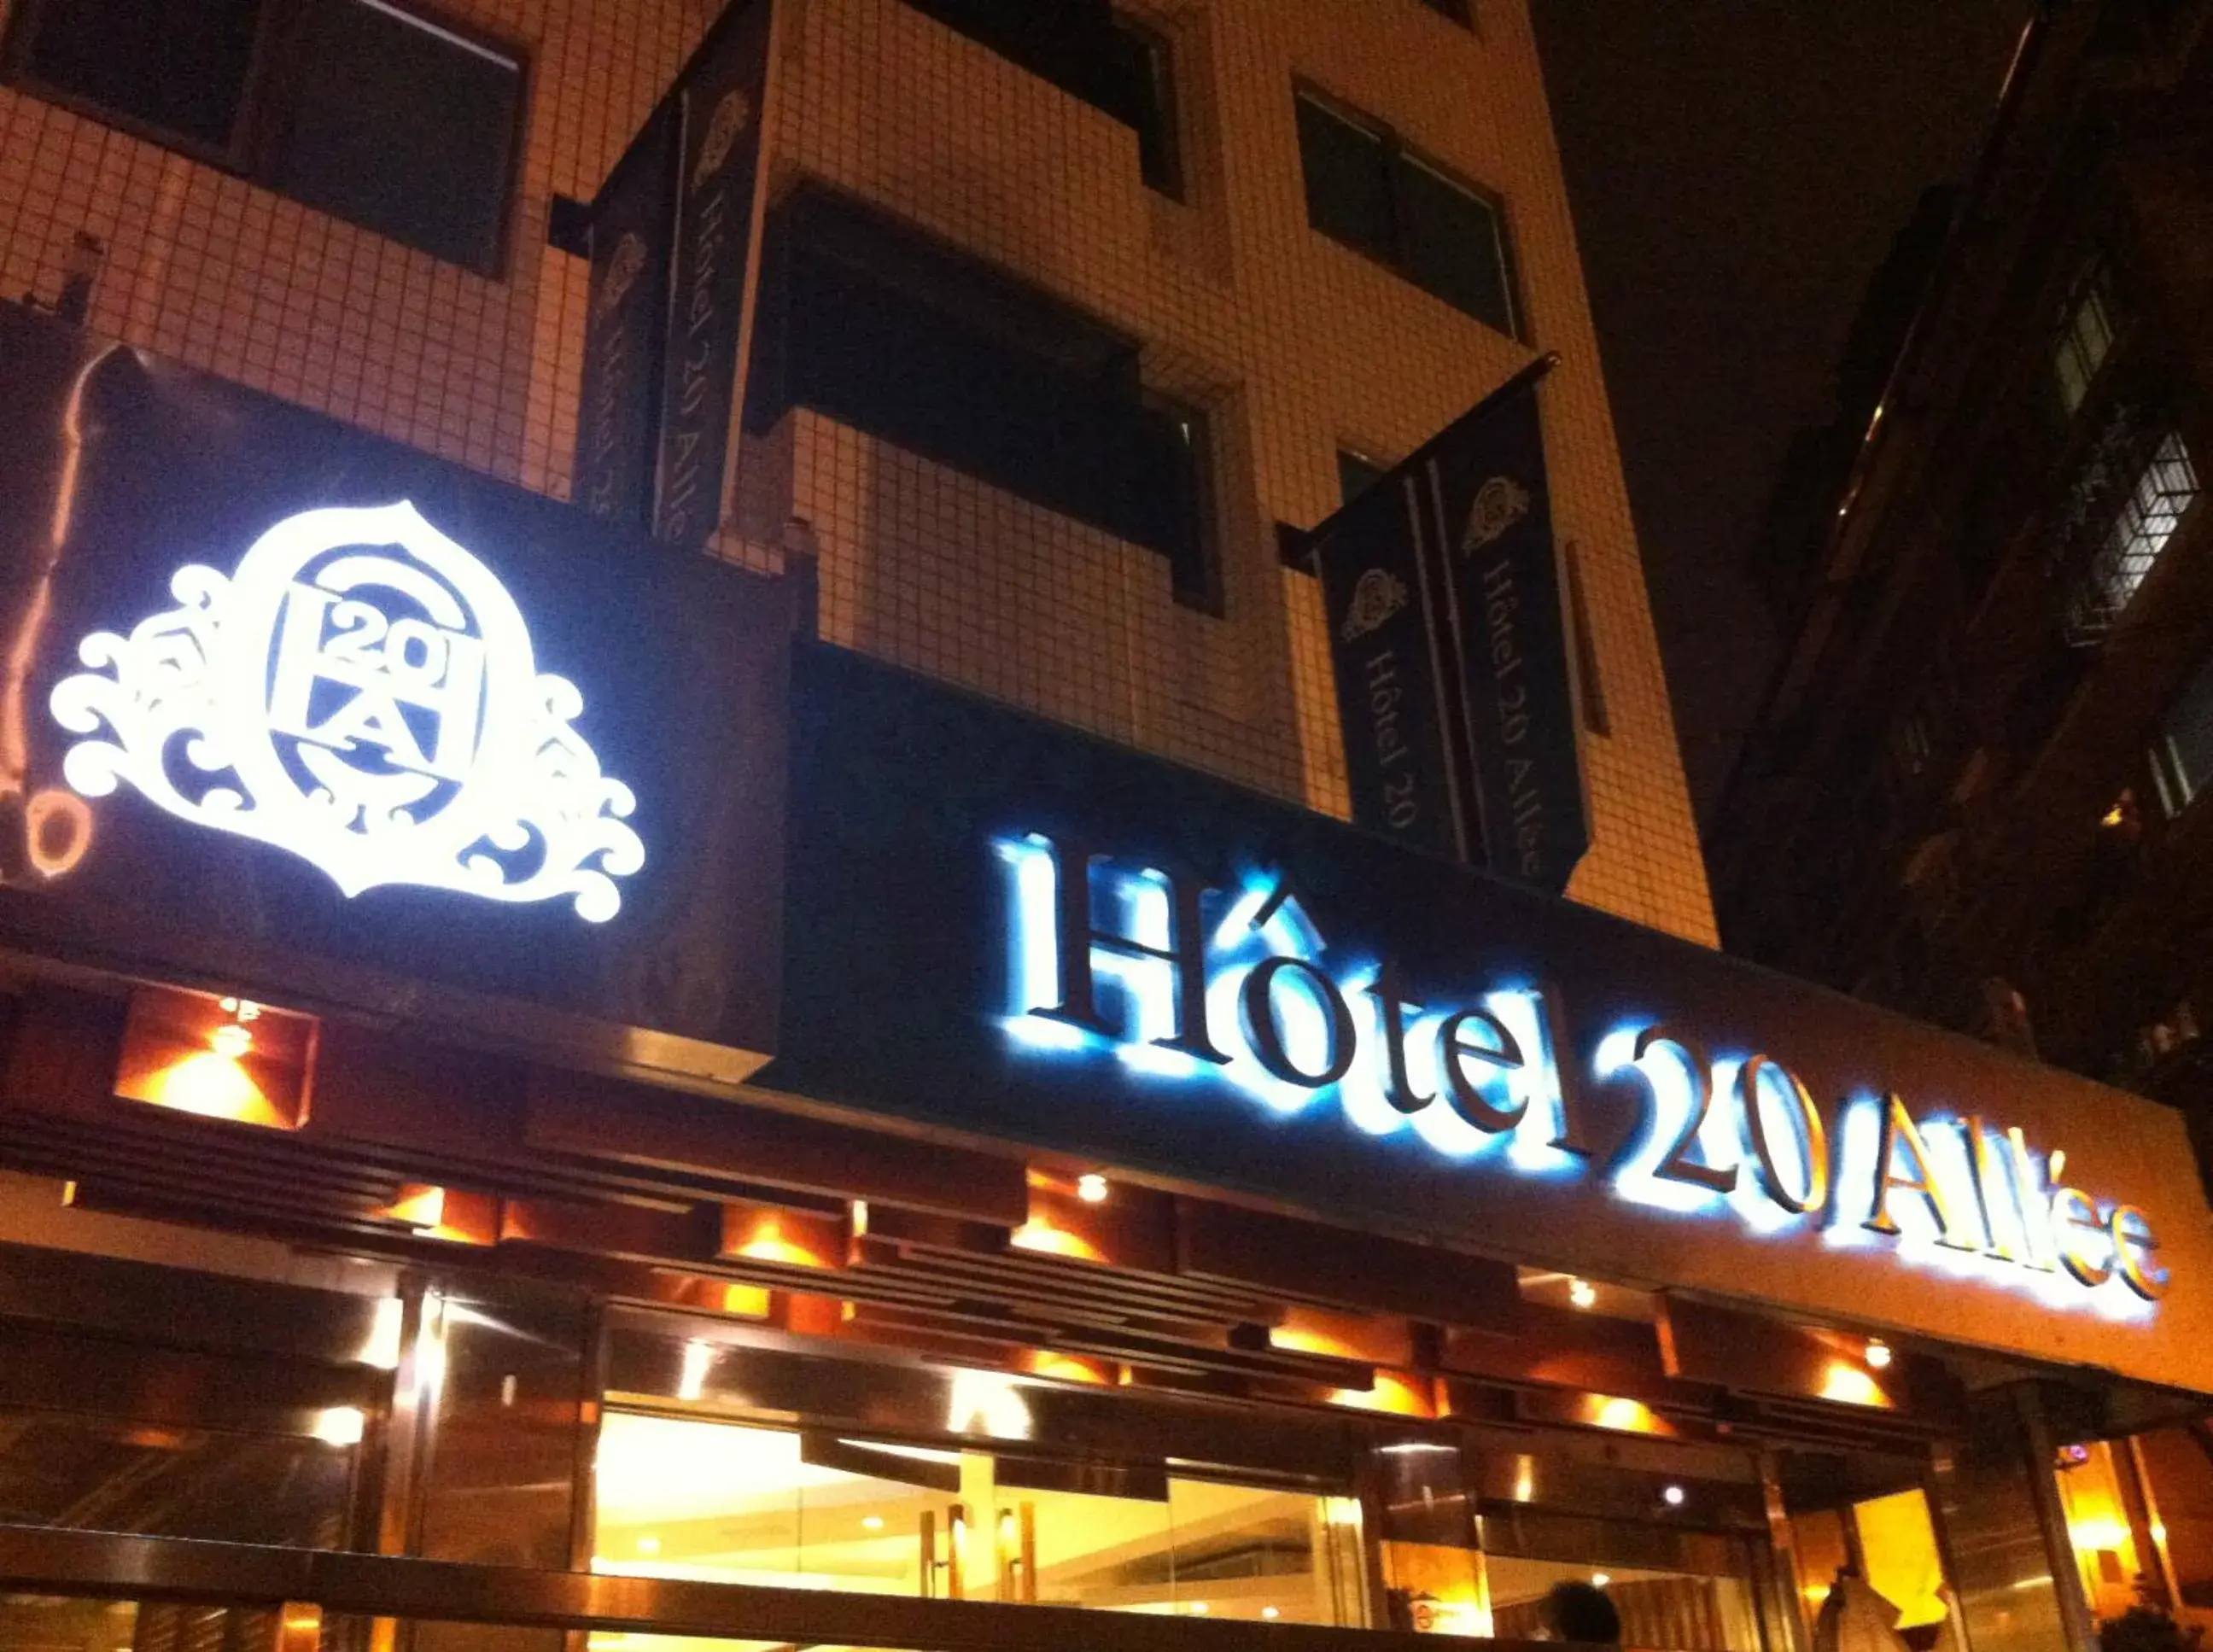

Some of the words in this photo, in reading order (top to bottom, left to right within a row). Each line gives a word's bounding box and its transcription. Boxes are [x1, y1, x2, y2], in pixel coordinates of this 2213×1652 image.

[1482, 557, 1523, 680] Hôtel
[1365, 649, 1409, 767] Hôtel
[1498, 684, 1531, 745] 20
[1383, 771, 1418, 830] 20
[999, 835, 1592, 1168] Hôtel
[1598, 1022, 1827, 1217] 20
[1836, 1091, 2169, 1309] Allée
